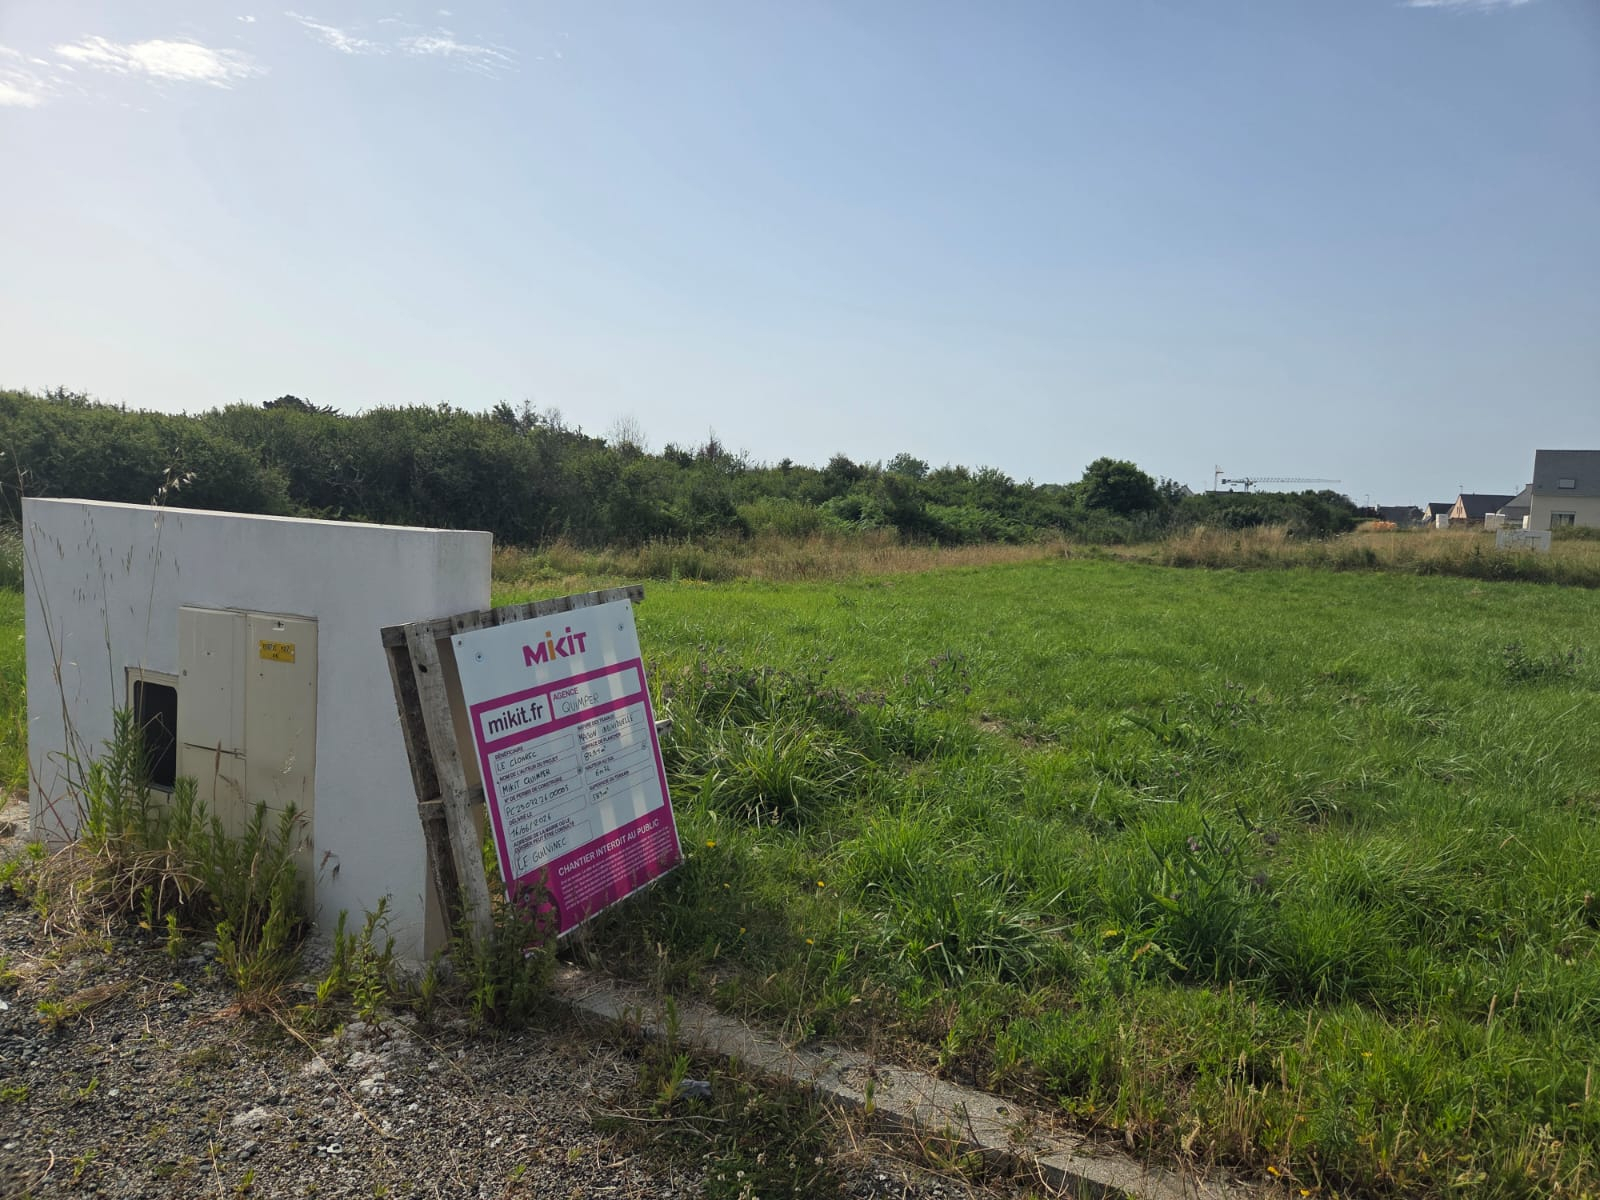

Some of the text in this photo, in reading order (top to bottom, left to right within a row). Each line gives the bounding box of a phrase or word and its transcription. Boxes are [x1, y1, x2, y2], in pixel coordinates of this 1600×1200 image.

[553, 688, 578, 700] AGENCE
[488, 703, 543, 734] mikit.fr
[497, 761, 505, 771] LE
[558, 819, 659, 875] CHANTIER INTERDIT AU PUBLIC
